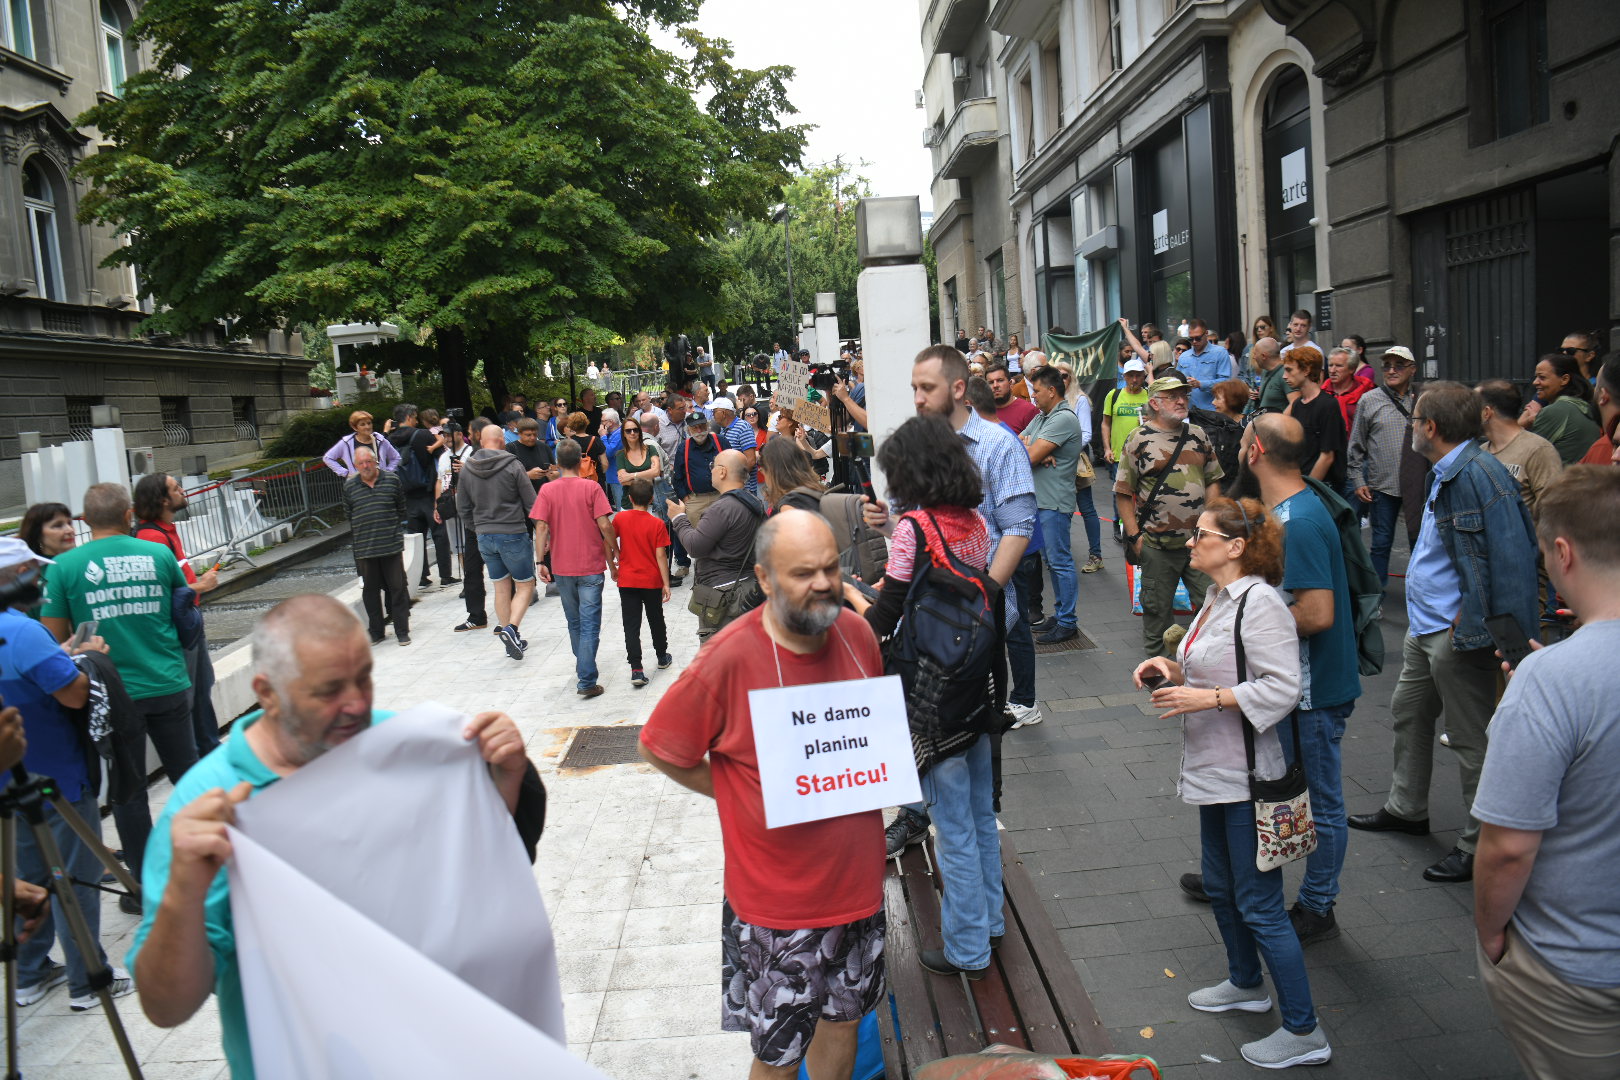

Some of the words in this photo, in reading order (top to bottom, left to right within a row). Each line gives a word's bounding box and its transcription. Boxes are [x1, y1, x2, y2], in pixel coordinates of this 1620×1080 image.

[1282, 178, 1307, 204] arte
[85, 585, 147, 605] DOKTORI
[148, 585, 164, 597] ZA
[92, 601, 160, 620] EKOLOGIJU
[791, 710, 817, 726] Ne
[824, 706, 871, 722] damo
[804, 735, 869, 760] planinu
[795, 762, 888, 796] Staricu!
